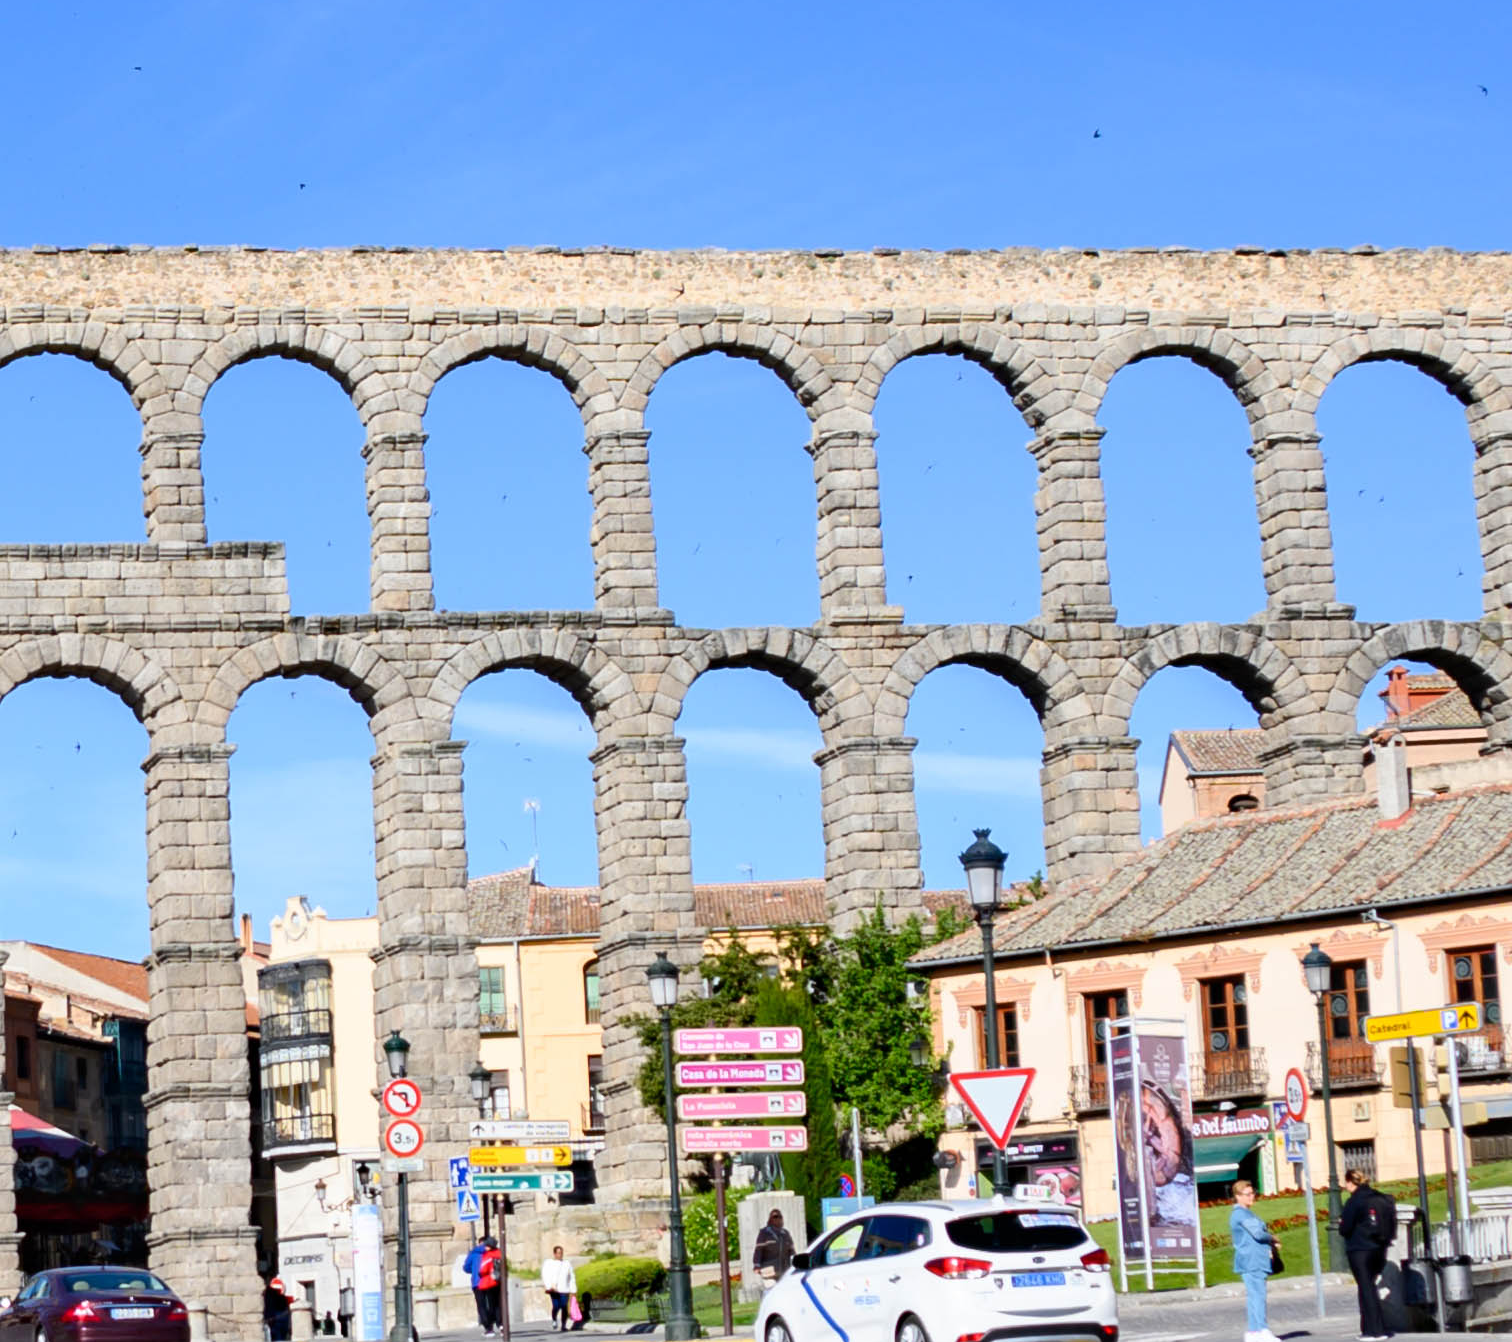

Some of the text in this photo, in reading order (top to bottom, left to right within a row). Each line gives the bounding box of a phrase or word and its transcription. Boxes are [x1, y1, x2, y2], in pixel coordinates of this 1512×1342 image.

[1369, 1021, 1412, 1035] Catedral
[682, 1069, 705, 1080] Casa
[706, 1069, 718, 1080] de
[730, 1067, 766, 1079] Moneda
[1201, 1116, 1222, 1135] del
